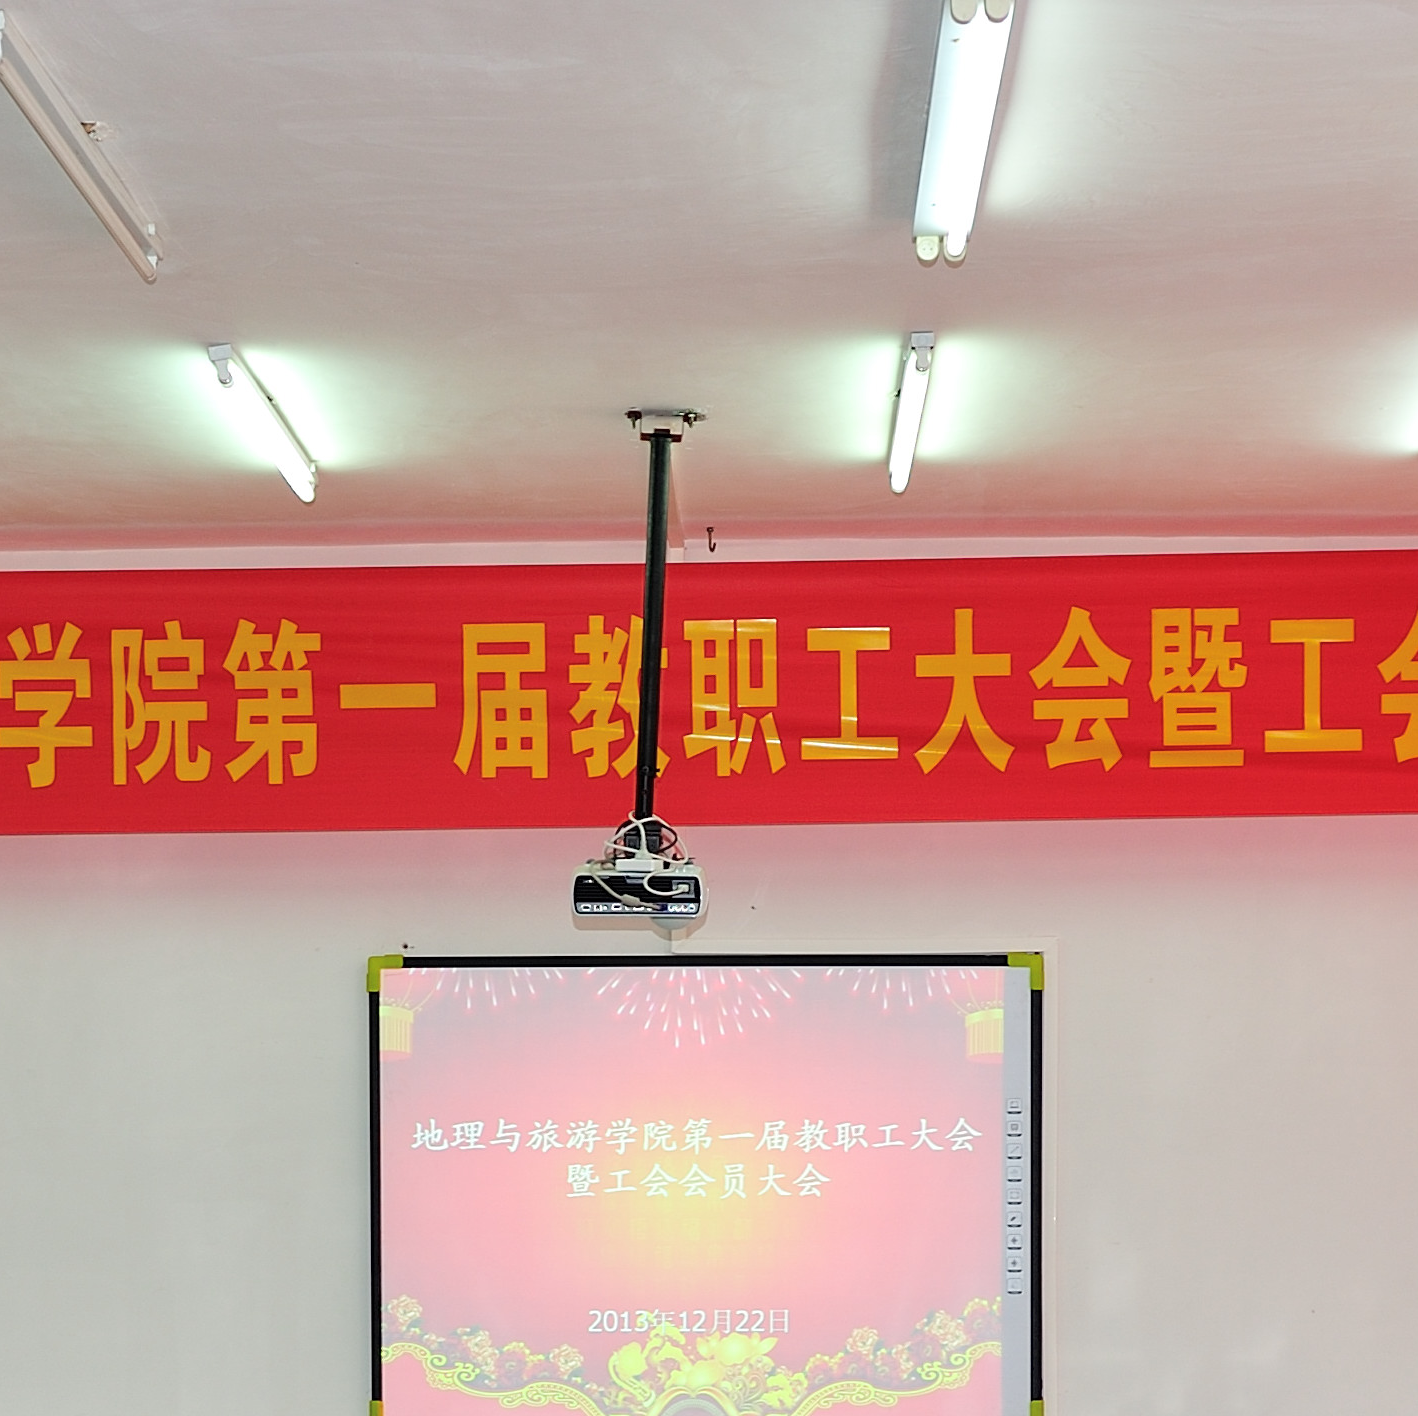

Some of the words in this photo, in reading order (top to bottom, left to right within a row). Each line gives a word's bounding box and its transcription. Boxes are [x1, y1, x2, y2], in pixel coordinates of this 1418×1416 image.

[411, 1117, 982, 1155] 地理与旅游学院第一届教职工大会
[566, 1163, 831, 1198] 暨工会会员大会
[588, 1308, 790, 1334] 2013年12月22日
